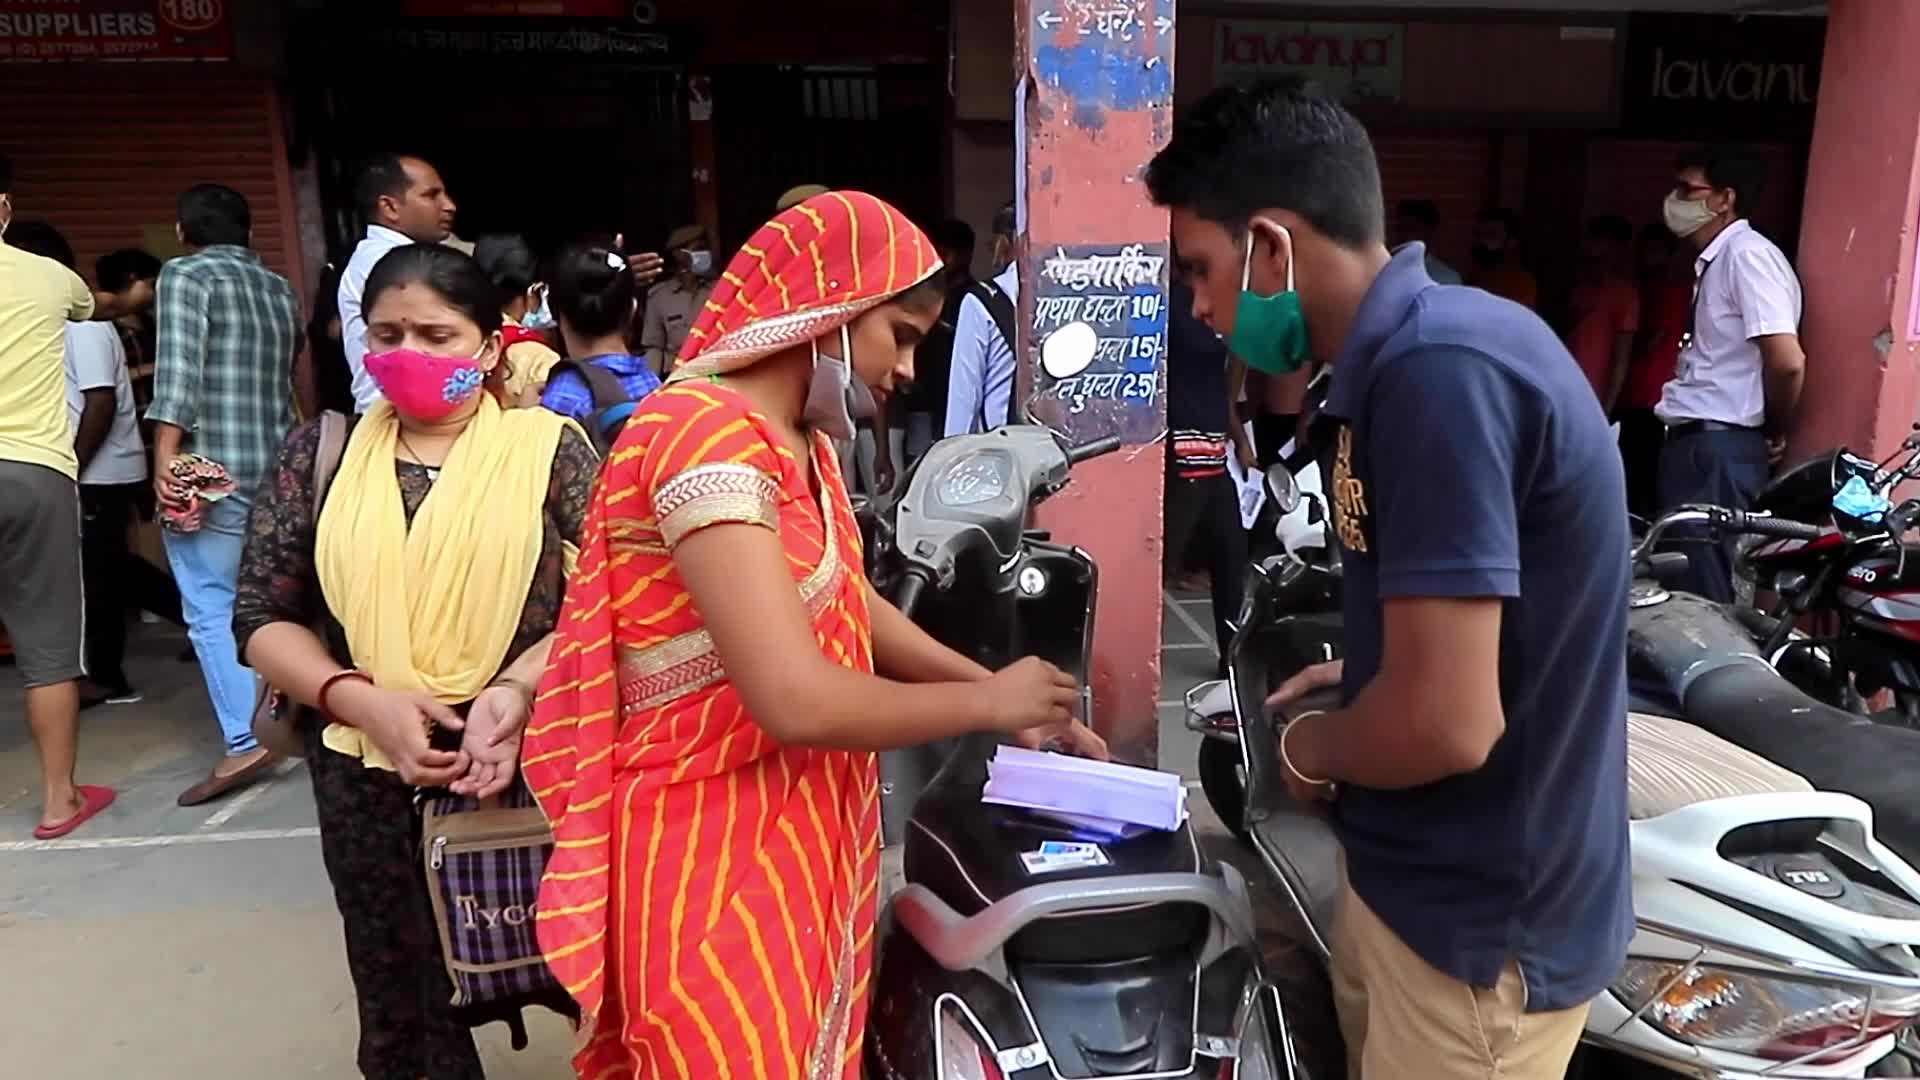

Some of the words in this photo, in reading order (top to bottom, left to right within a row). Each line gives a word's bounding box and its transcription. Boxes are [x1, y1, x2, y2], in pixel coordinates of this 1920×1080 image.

[168, 0, 214, 21] 180
[0, 12, 157, 37] SUPPLIERS
[1130, 294, 1165, 322] 10/-
[1784, 871, 1830, 884] TVS
